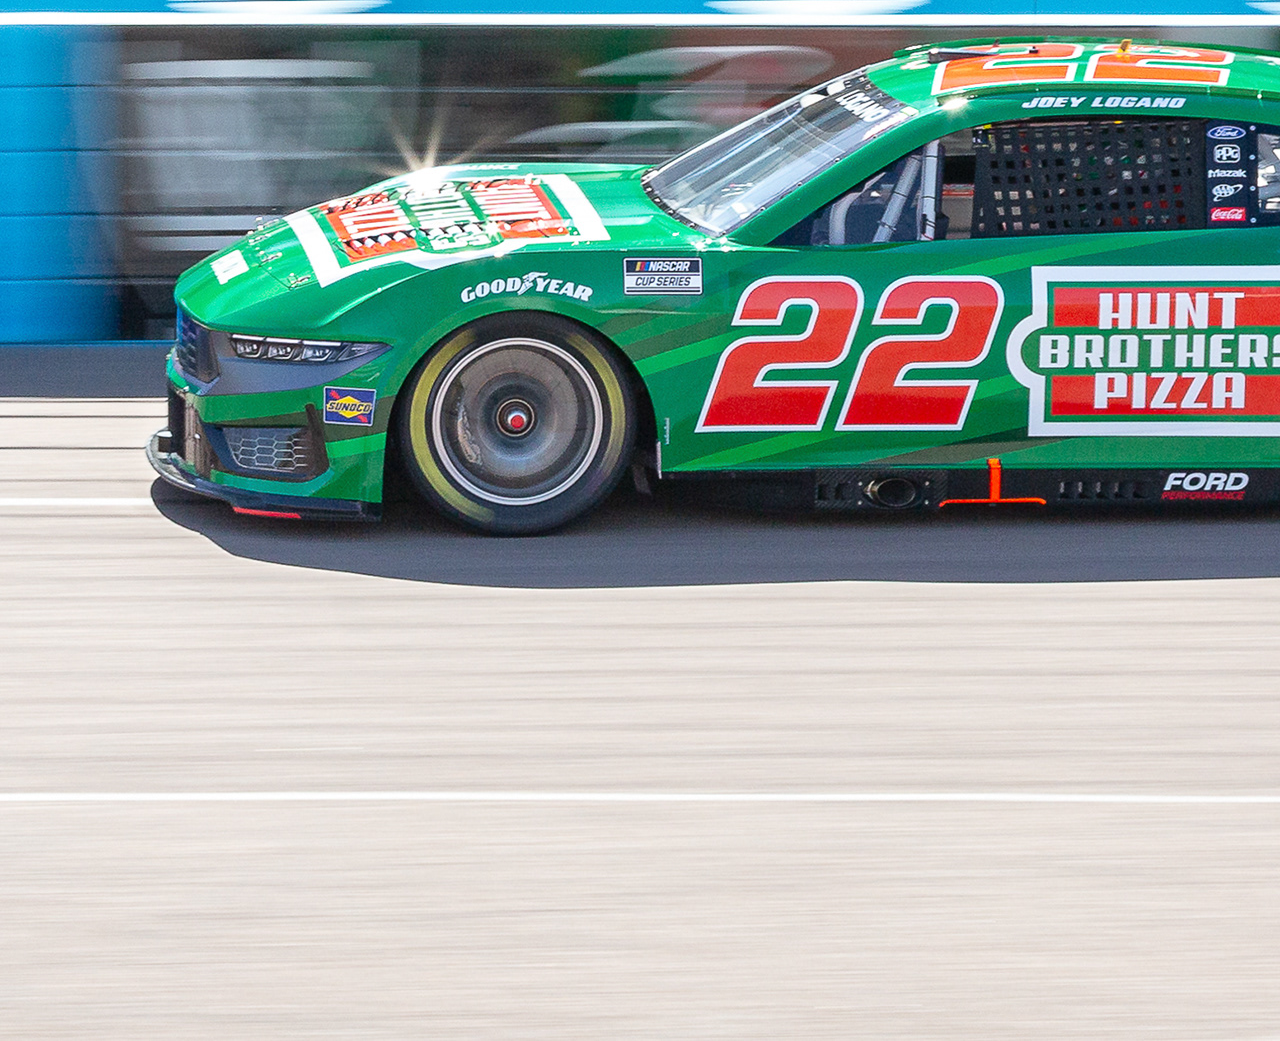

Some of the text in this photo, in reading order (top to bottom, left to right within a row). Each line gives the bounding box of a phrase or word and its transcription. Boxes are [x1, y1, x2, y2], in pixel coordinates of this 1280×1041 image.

[931, 42, 1235, 96] 22
[835, 88, 891, 123] LOGANO
[1021, 96, 1187, 110] JOEY LOGANO
[1216, 146, 1240, 161] PPG
[1207, 169, 1248, 178] Mazak
[648, 262, 692, 272] NASCAR
[635, 276, 692, 287] CUP SERIES
[1098, 291, 1246, 330] HUNT
[694, 274, 1005, 434] 22
[1093, 371, 1247, 410] PIZZA
[327, 401, 372, 413] SUNOCO
[1163, 472, 1250, 491] FORD
[1160, 491, 1248, 501] PERFORMANCE
